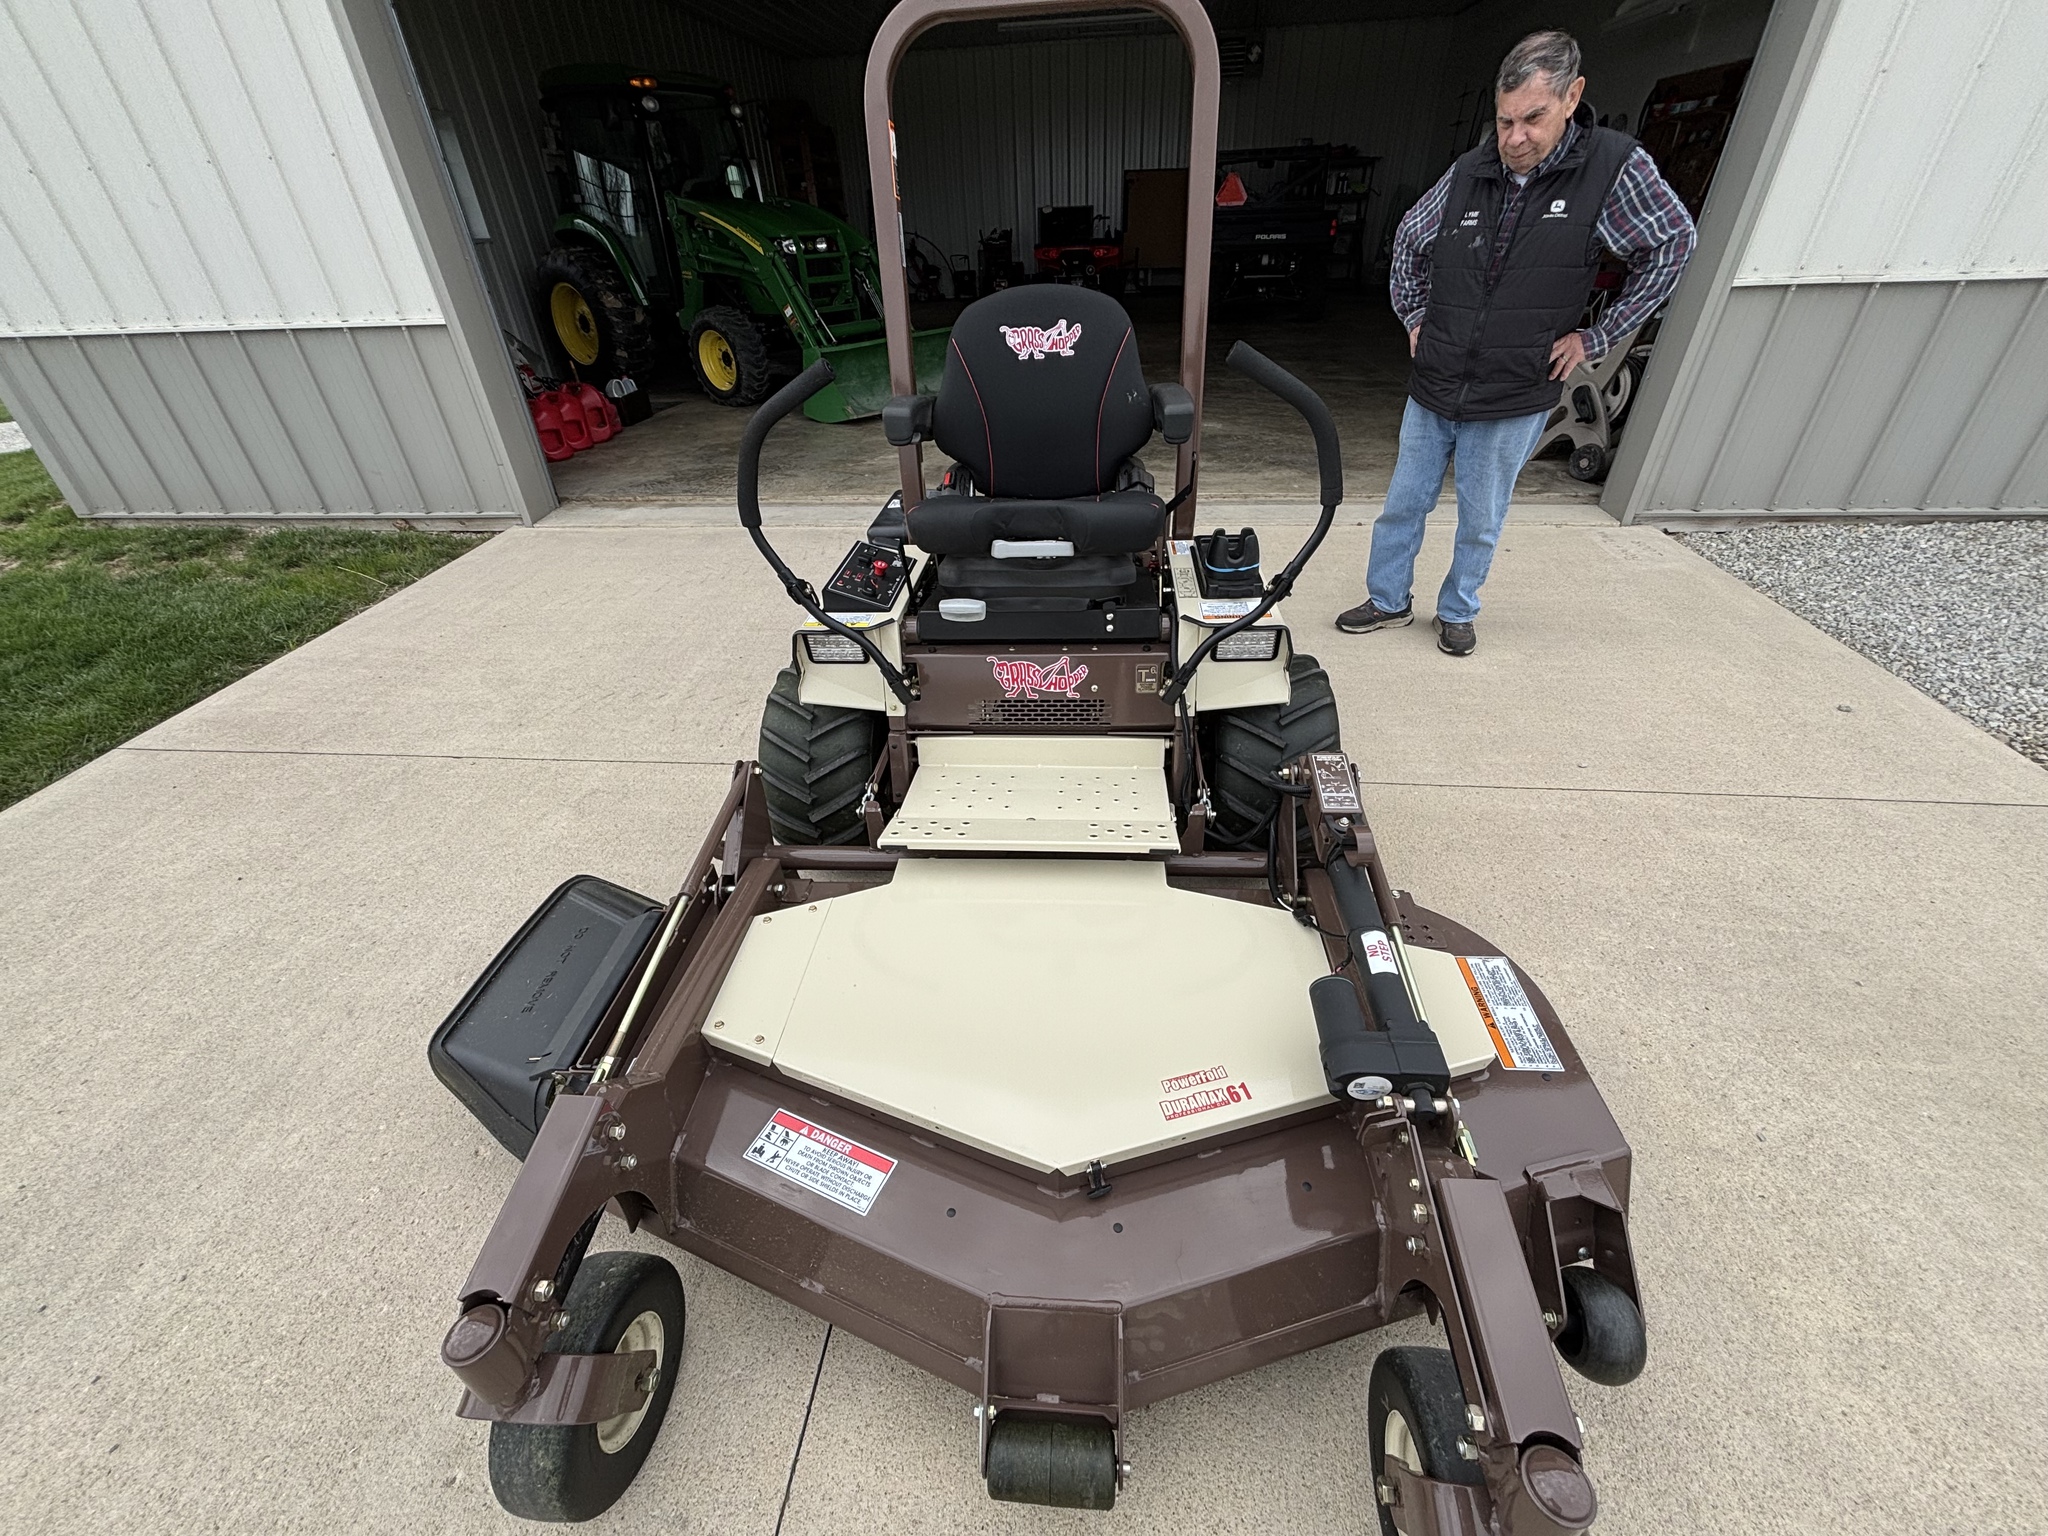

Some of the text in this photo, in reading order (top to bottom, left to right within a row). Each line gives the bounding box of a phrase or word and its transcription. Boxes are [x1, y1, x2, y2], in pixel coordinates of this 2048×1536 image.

[1367, 940, 1392, 962] NO STEP
[521, 927, 589, 1014] DO NOT REMOVE
[1471, 986, 1491, 1019] WARNING
[1227, 1082, 1252, 1103] 61
[1166, 1100, 1230, 1120] PROFESSIONAL CUT
[810, 1129, 853, 1154] DANGER
[797, 1150, 871, 1187] DEATH FROM THROWN OBJECTS
[810, 1149, 826, 1159] AVOID
[826, 1156, 846, 1168] SERIOUS
[846, 1165, 863, 1176] INJURY
[814, 1165, 830, 1175] BLADE
[822, 1148, 859, 1168] KEEP AWAY!
[784, 1165, 801, 1175] CHUTE
[808, 1176, 820, 1185] SIDE
[819, 1181, 839, 1194] SHIELDS
[784, 1158, 871, 1202] NEVER OPERATE WITHOUT DISCHARGE
